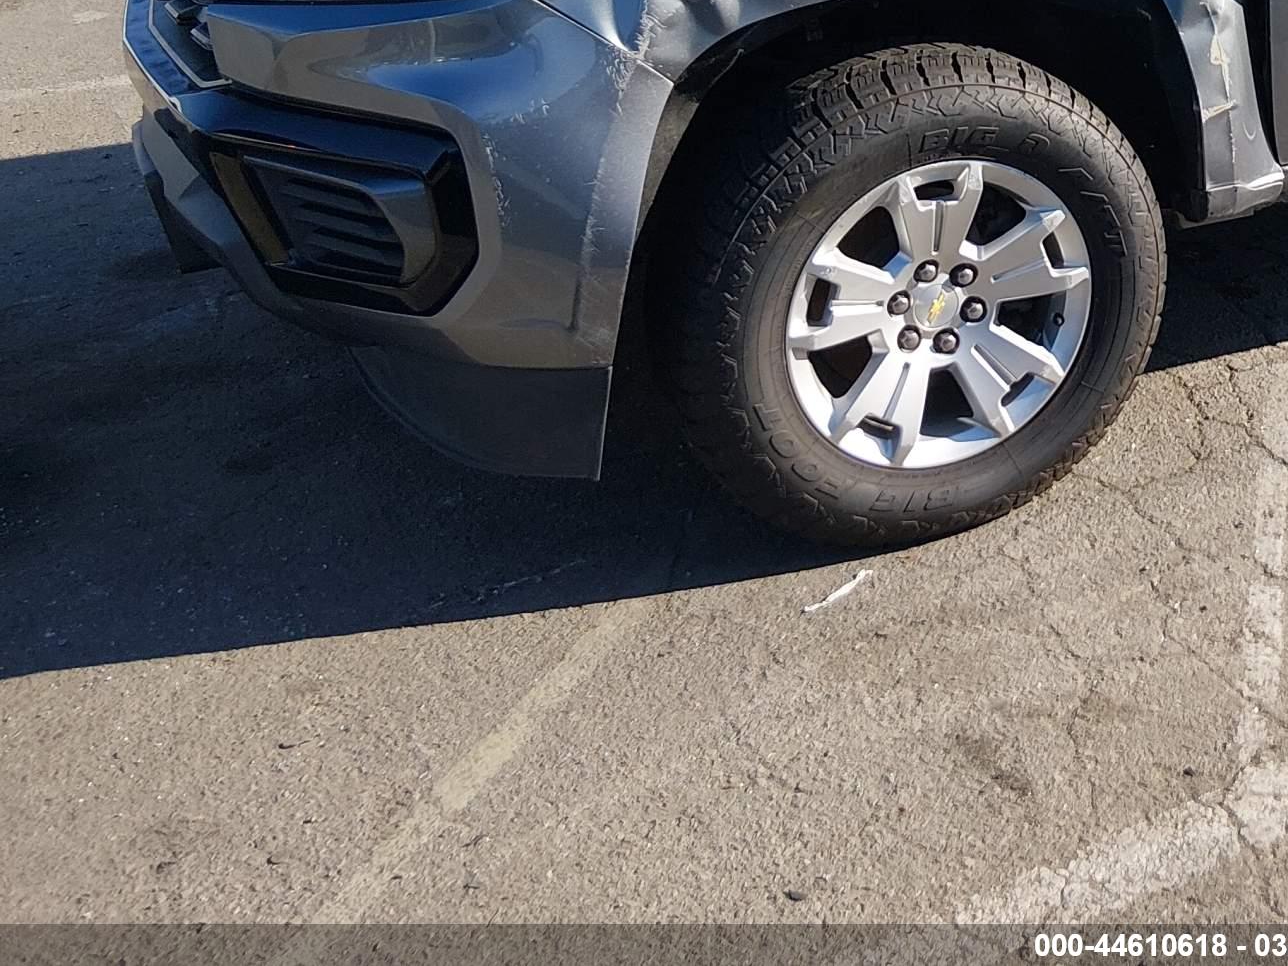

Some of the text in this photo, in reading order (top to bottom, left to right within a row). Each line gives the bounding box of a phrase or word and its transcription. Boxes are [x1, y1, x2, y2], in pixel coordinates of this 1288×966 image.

[919, 125, 1008, 154] BIG
[753, 403, 954, 513] BIG FOOT
